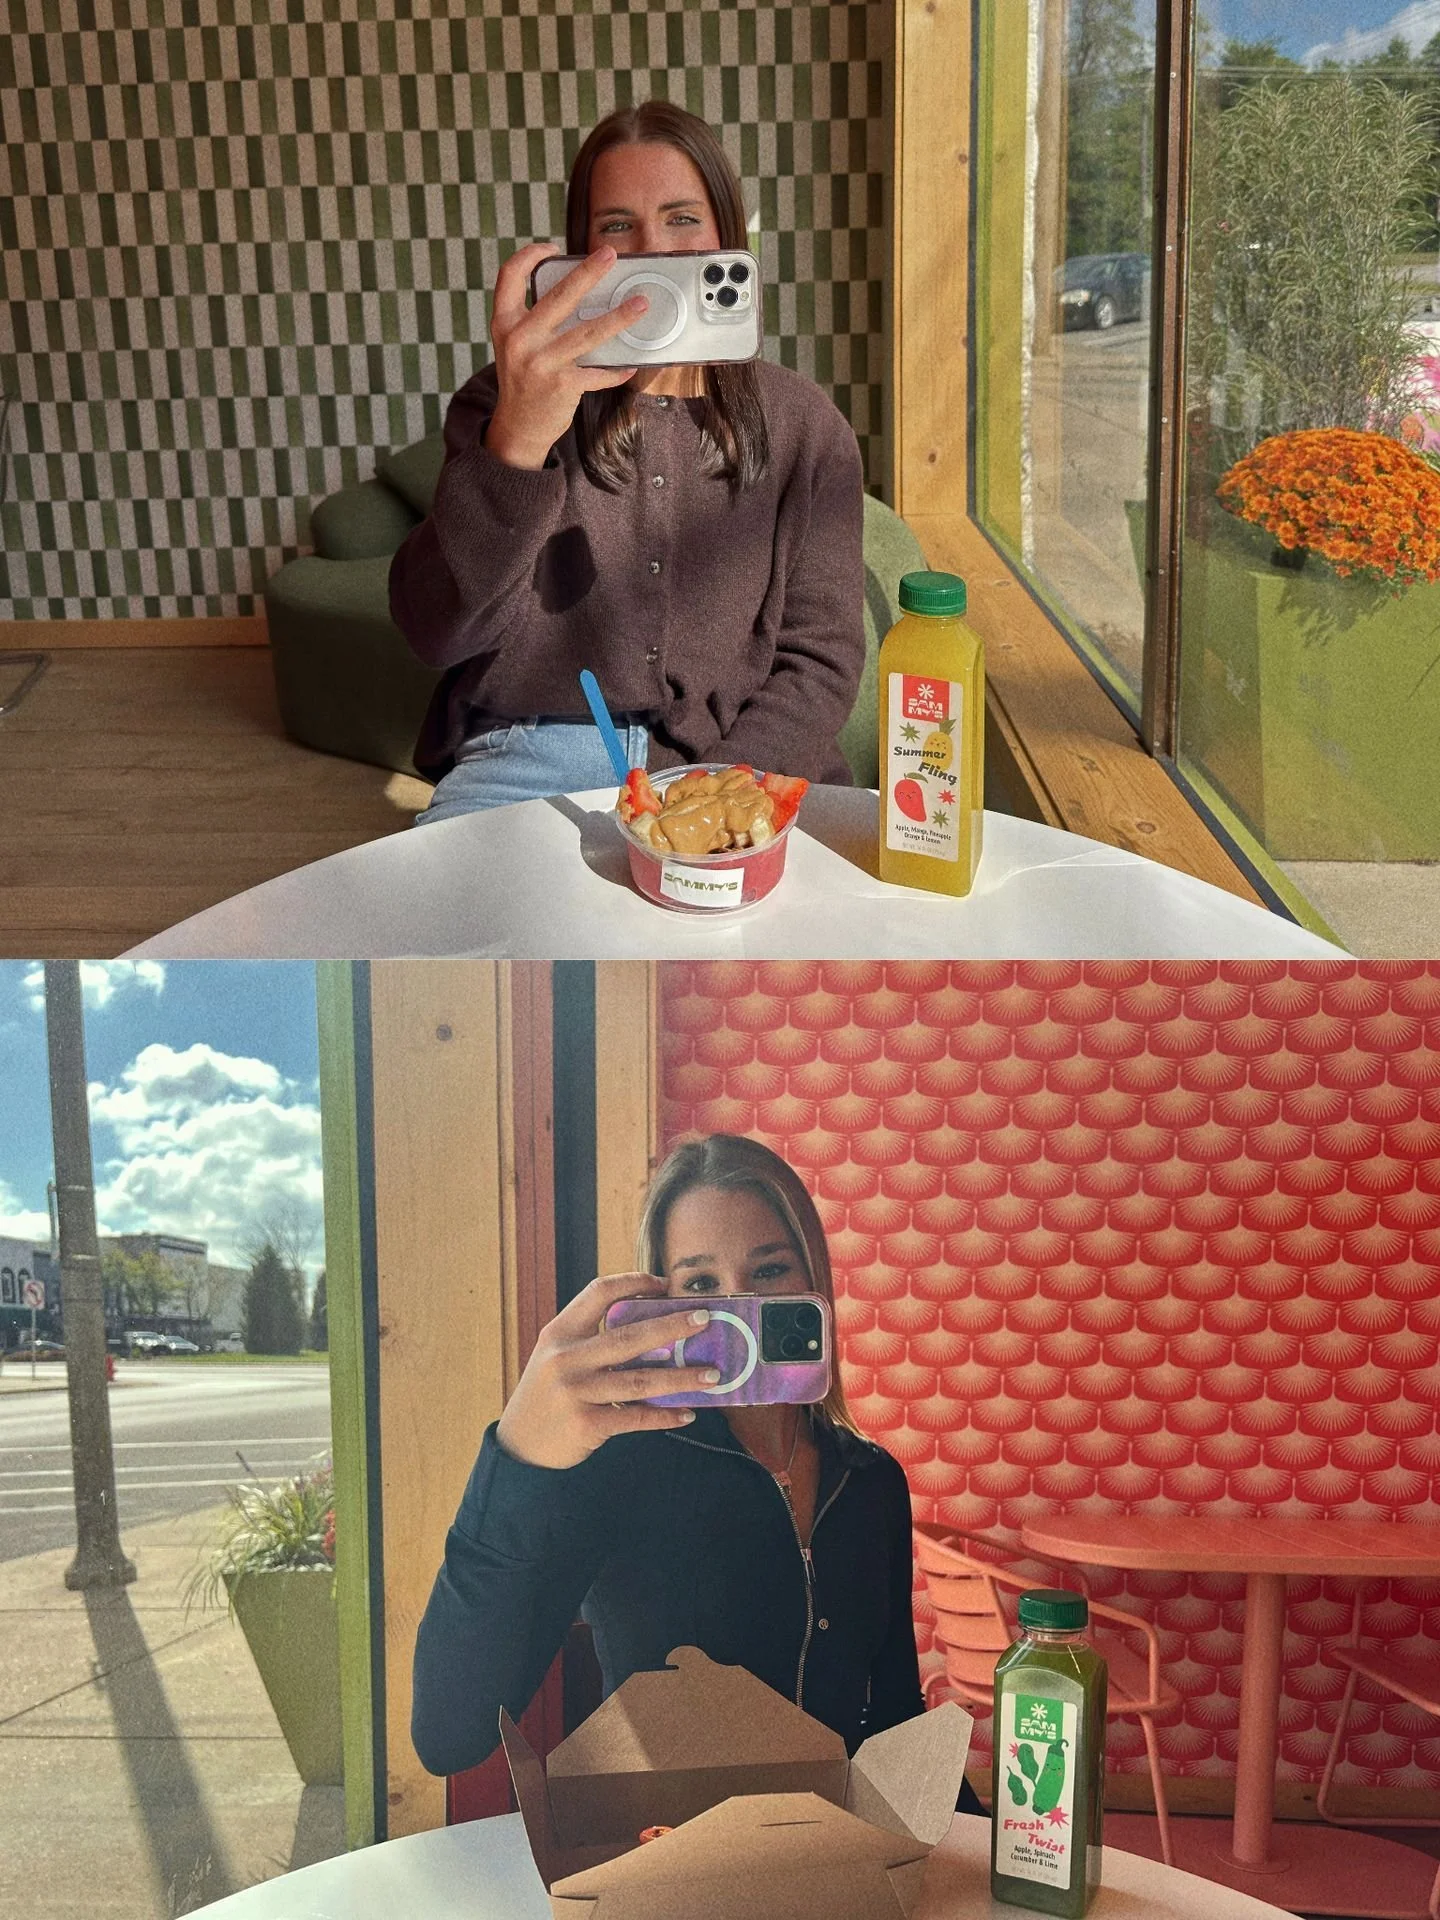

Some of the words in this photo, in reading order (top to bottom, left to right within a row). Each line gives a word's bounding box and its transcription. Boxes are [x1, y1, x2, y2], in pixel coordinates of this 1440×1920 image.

[893, 746, 946, 759] Summer
[918, 761, 957, 786] Fling
[895, 824, 911, 833] Apple,
[930, 829, 952, 841] Pineapple
[904, 832, 921, 841] Orange
[664, 872, 738, 891] SAMMY'S
[1004, 1819, 1044, 1830] Fresh
[1028, 1832, 1065, 1854] Twist
[1014, 1845, 1032, 1855] Apple,
[1034, 1849, 1056, 1860] Spinach
[1011, 1853, 1038, 1864] Cucumber
[1045, 1860, 1058, 1870] Lime
